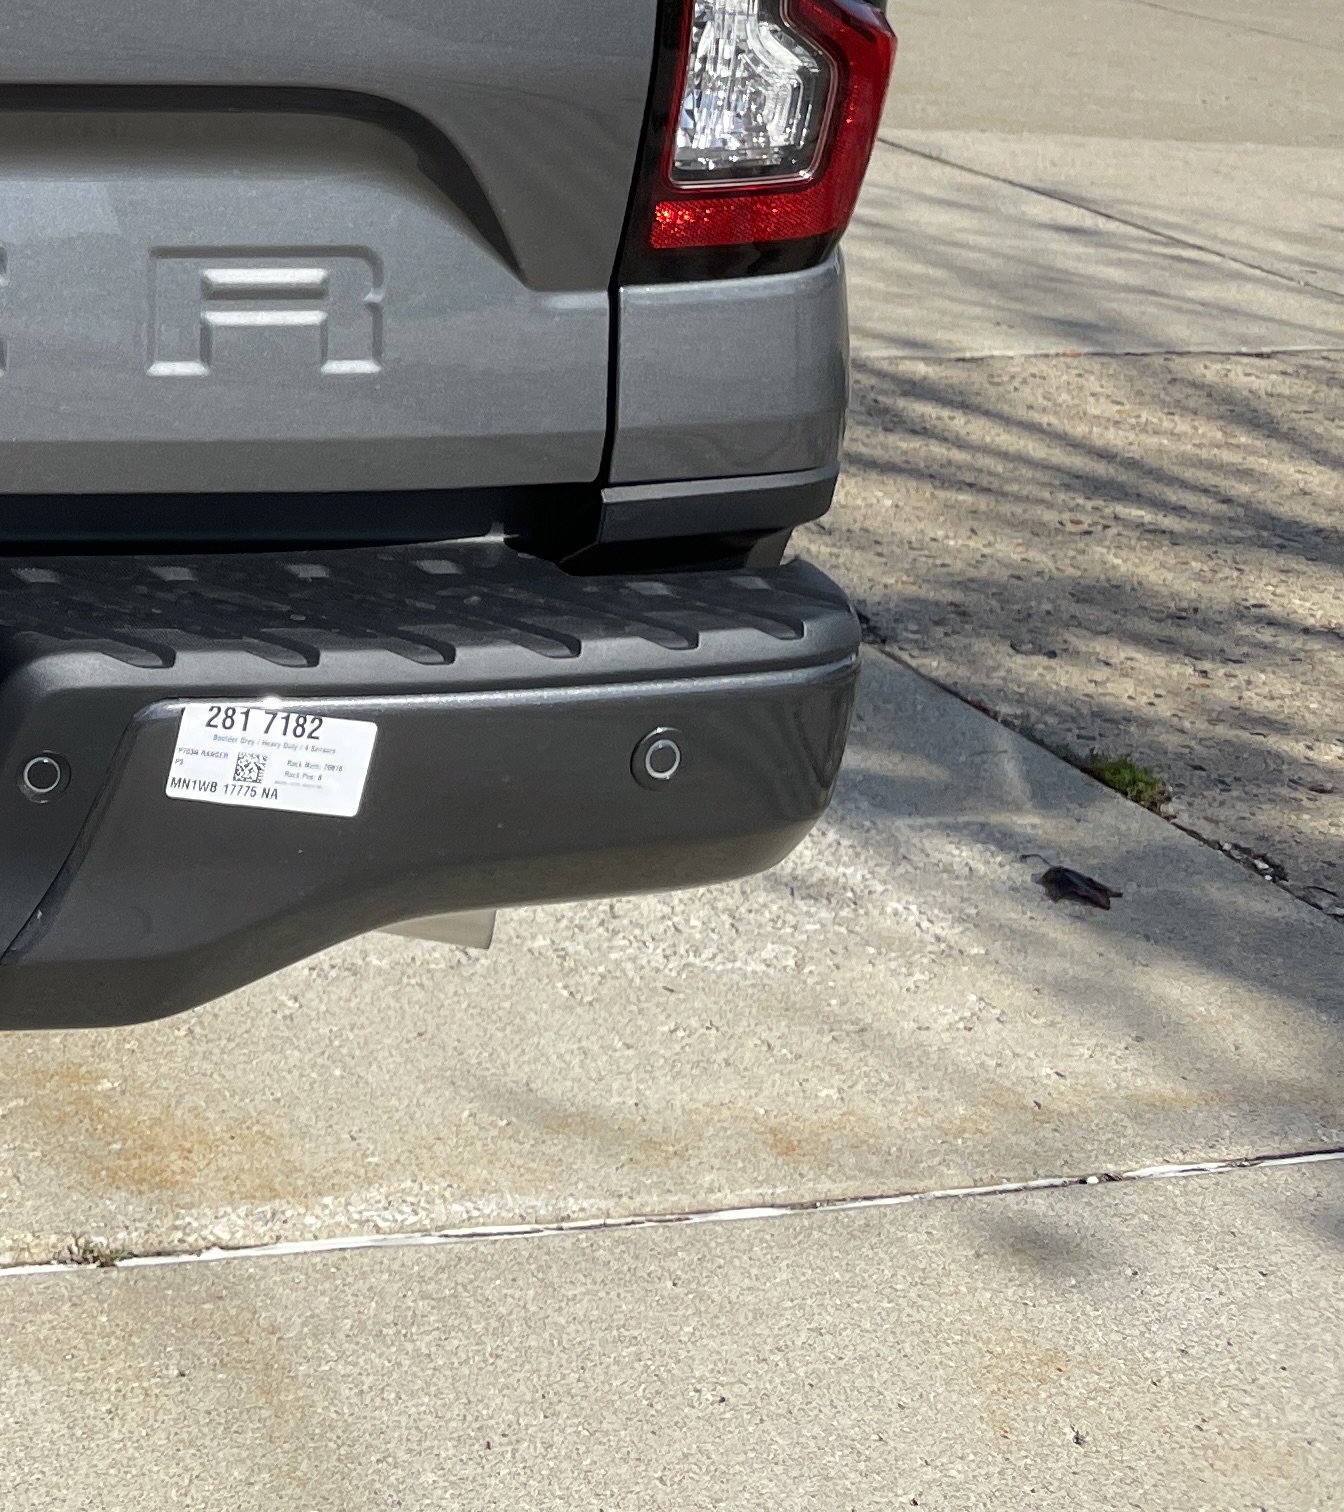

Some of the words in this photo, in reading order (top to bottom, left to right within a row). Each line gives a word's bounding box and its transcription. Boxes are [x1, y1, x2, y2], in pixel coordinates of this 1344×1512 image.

[205, 705, 251, 732] 281
[263, 710, 324, 740] 7182
[170, 776, 218, 793] MN1WB
[223, 783, 257, 798] 17775
[261, 787, 279, 800] NA
